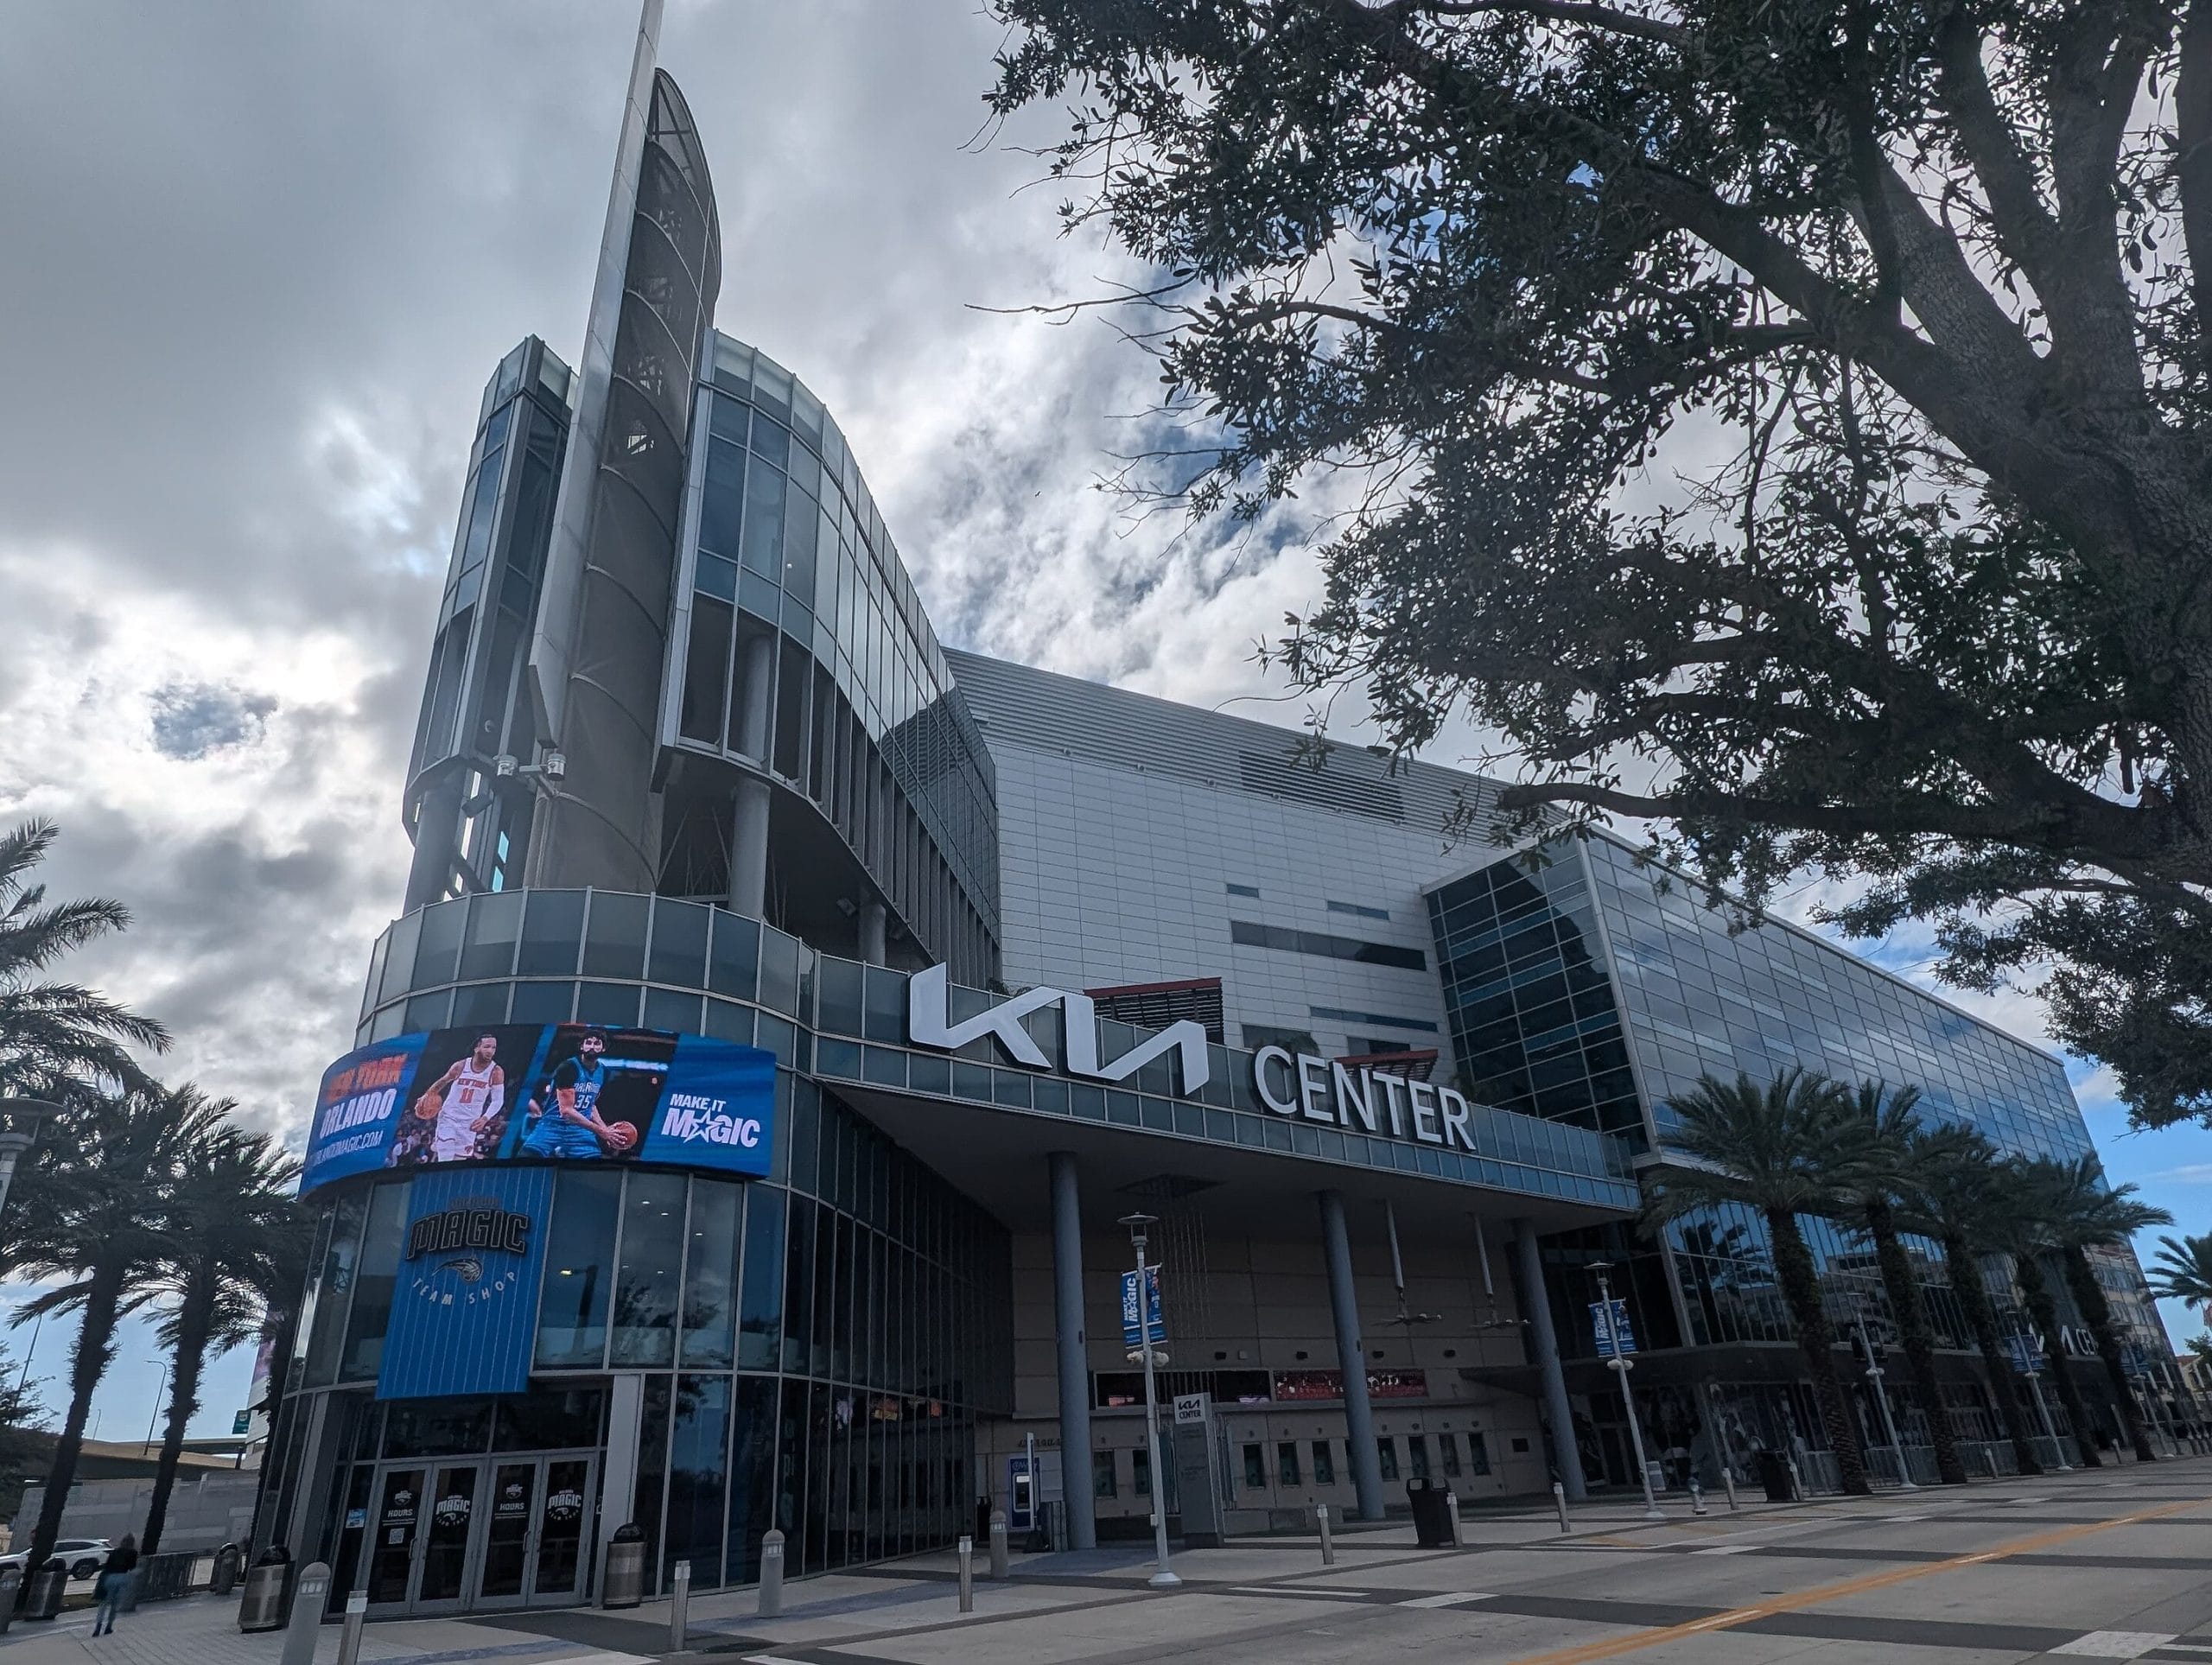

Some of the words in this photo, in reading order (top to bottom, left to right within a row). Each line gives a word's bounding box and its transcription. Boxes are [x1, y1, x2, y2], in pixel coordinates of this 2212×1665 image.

[910, 962, 1210, 1096] KIA
[1253, 1045, 1476, 1150] CENTER
[574, 1094, 592, 1109] 35
[670, 1093, 710, 1109] MAKE
[712, 1099, 726, 1112] IT
[320, 1088, 397, 1140] ORLANDO
[406, 1209, 529, 1261] MAGIC
[412, 1277, 453, 1306] TEAM
[468, 1271, 516, 1305] SHOP
[435, 1499, 471, 1516] MAGIC
[499, 1503, 524, 1511] HOURS
[548, 1493, 582, 1509] MAGIC
[387, 1509, 413, 1517] HOURS
